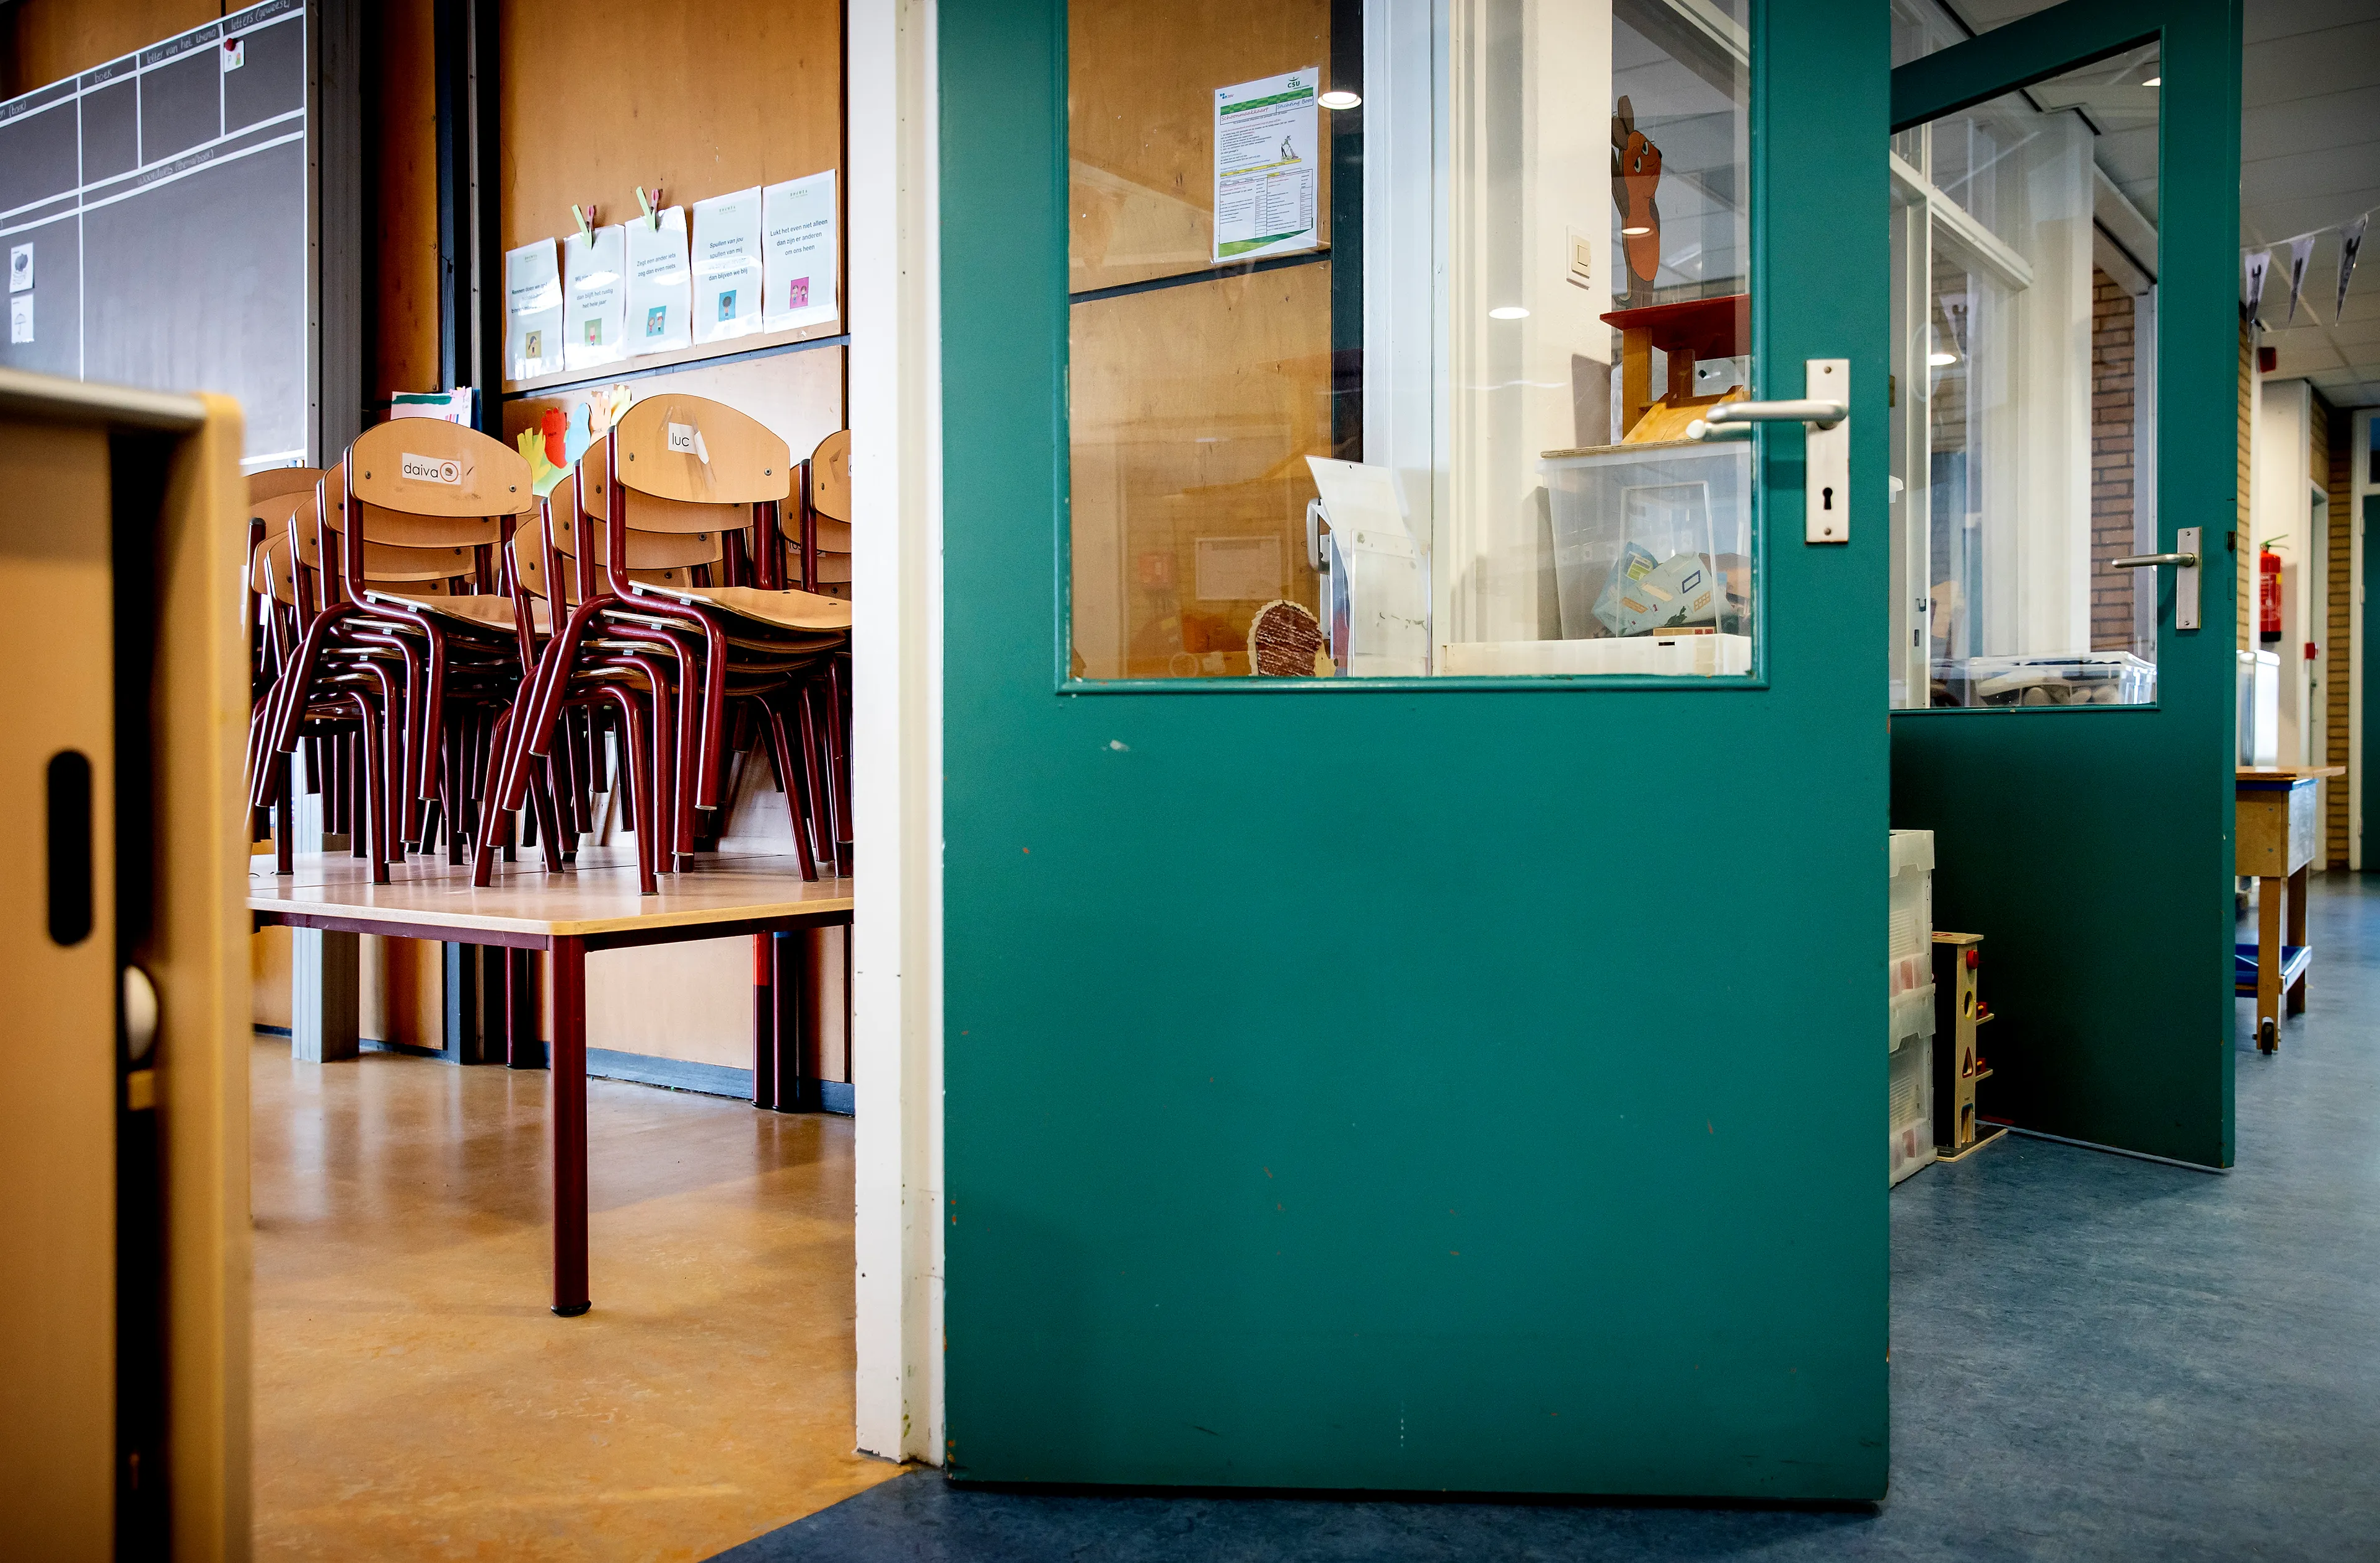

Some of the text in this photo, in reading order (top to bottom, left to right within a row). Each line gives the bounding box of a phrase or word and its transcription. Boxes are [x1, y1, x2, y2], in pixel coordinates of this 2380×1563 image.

[166, 45, 178, 56] van
[1221, 107, 1269, 121] Schoonmaakkaart
[1277, 99, 1300, 110] Stichting
[802, 232, 822, 240] anderen
[710, 251, 726, 259] spullen
[718, 271, 733, 280] blijven
[672, 433, 690, 447] luc
[403, 462, 439, 478] daiva
